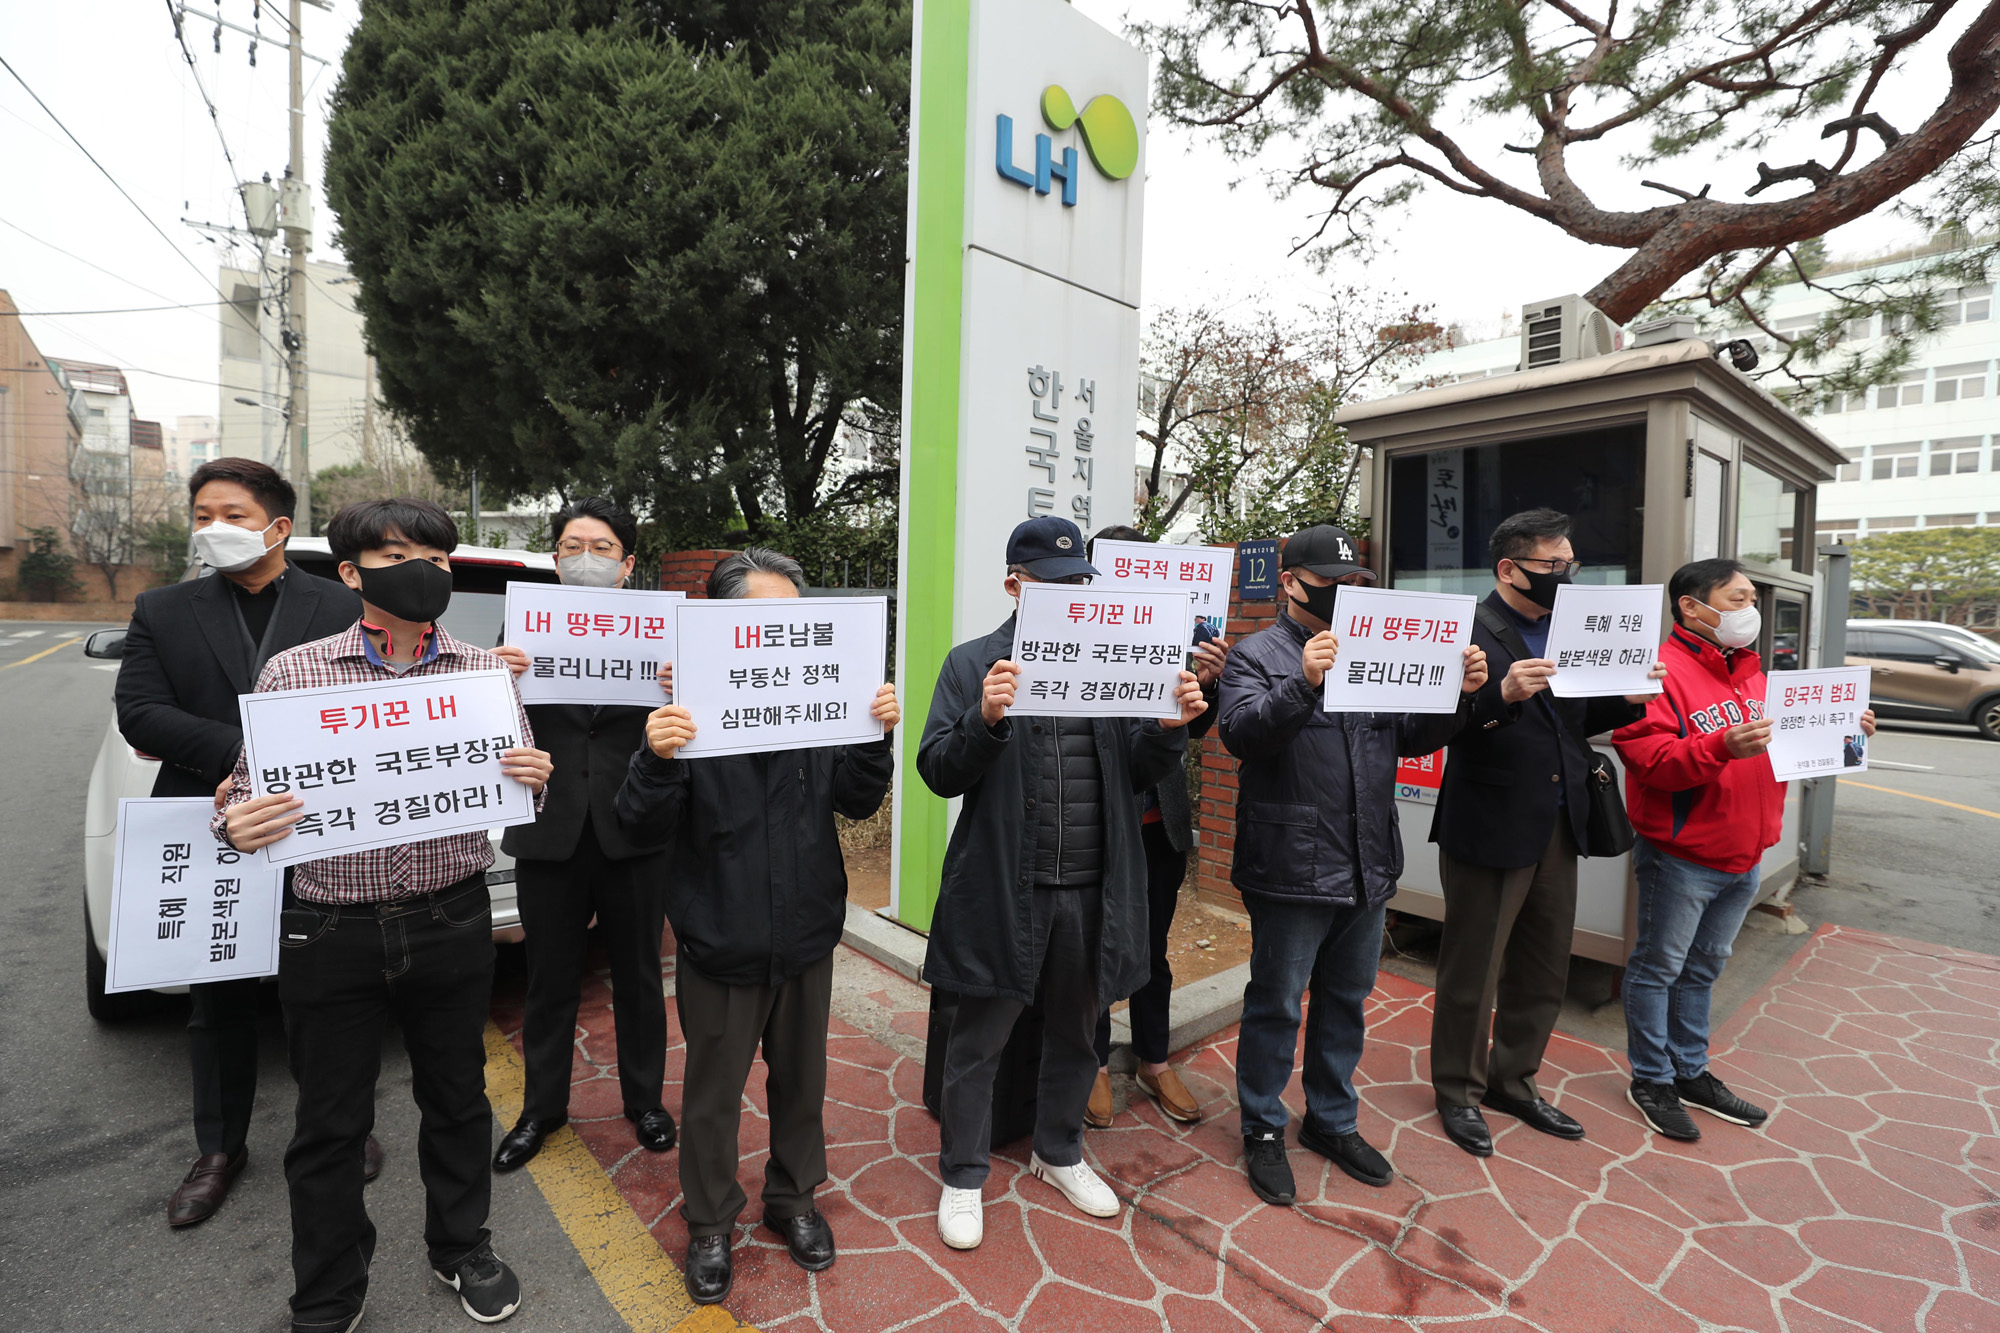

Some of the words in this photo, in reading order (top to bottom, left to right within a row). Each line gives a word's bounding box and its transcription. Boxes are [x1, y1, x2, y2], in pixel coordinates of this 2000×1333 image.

[996, 113, 1078, 208] LH
[1072, 378, 1096, 548] 서울지역
[1336, 537, 1354, 561] LA
[1114, 557, 1169, 580] 망국적
[1179, 561, 1214, 583] 범죄
[1249, 558, 1267, 582] 12
[1189, 592, 1199, 604] 구
[525, 610, 551, 633] LH
[567, 612, 665, 640] 땅투기꾼
[1067, 602, 1124, 625] 투기꾼
[1133, 605, 1153, 625] LH
[1584, 614, 1612, 633] 특혜
[1618, 614, 1643, 632] 직원
[735, 622, 834, 649] LH로남불
[1349, 615, 1373, 638] LH
[1382, 616, 1459, 643] 땅투기꾼
[1021, 640, 1081, 663] 방관한
[1091, 643, 1182, 665] 국토부장관
[1557, 649, 1613, 668] 발본색원
[728, 666, 791, 689] 부동산
[802, 663, 840, 686] 정책
[1030, 680, 1070, 700] 즉각
[1784, 684, 1823, 708] 망국적
[1830, 682, 1857, 703] 범죄
[320, 699, 410, 735] 투기꾼
[426, 695, 457, 721] LH
[720, 701, 848, 729] 심판해주세요!
[1689, 700, 1744, 735] RED
[1780, 715, 1806, 730] 엄정한
[1809, 714, 1826, 727] 수사
[1829, 712, 1845, 725] 촉구
[262, 757, 357, 795] 방관한
[375, 734, 516, 776] 국토부장관
[294, 806, 356, 838] 즉각
[161, 843, 191, 884] 직원
[157, 897, 188, 940] 특혜
[210, 878, 241, 962] 발본색원
